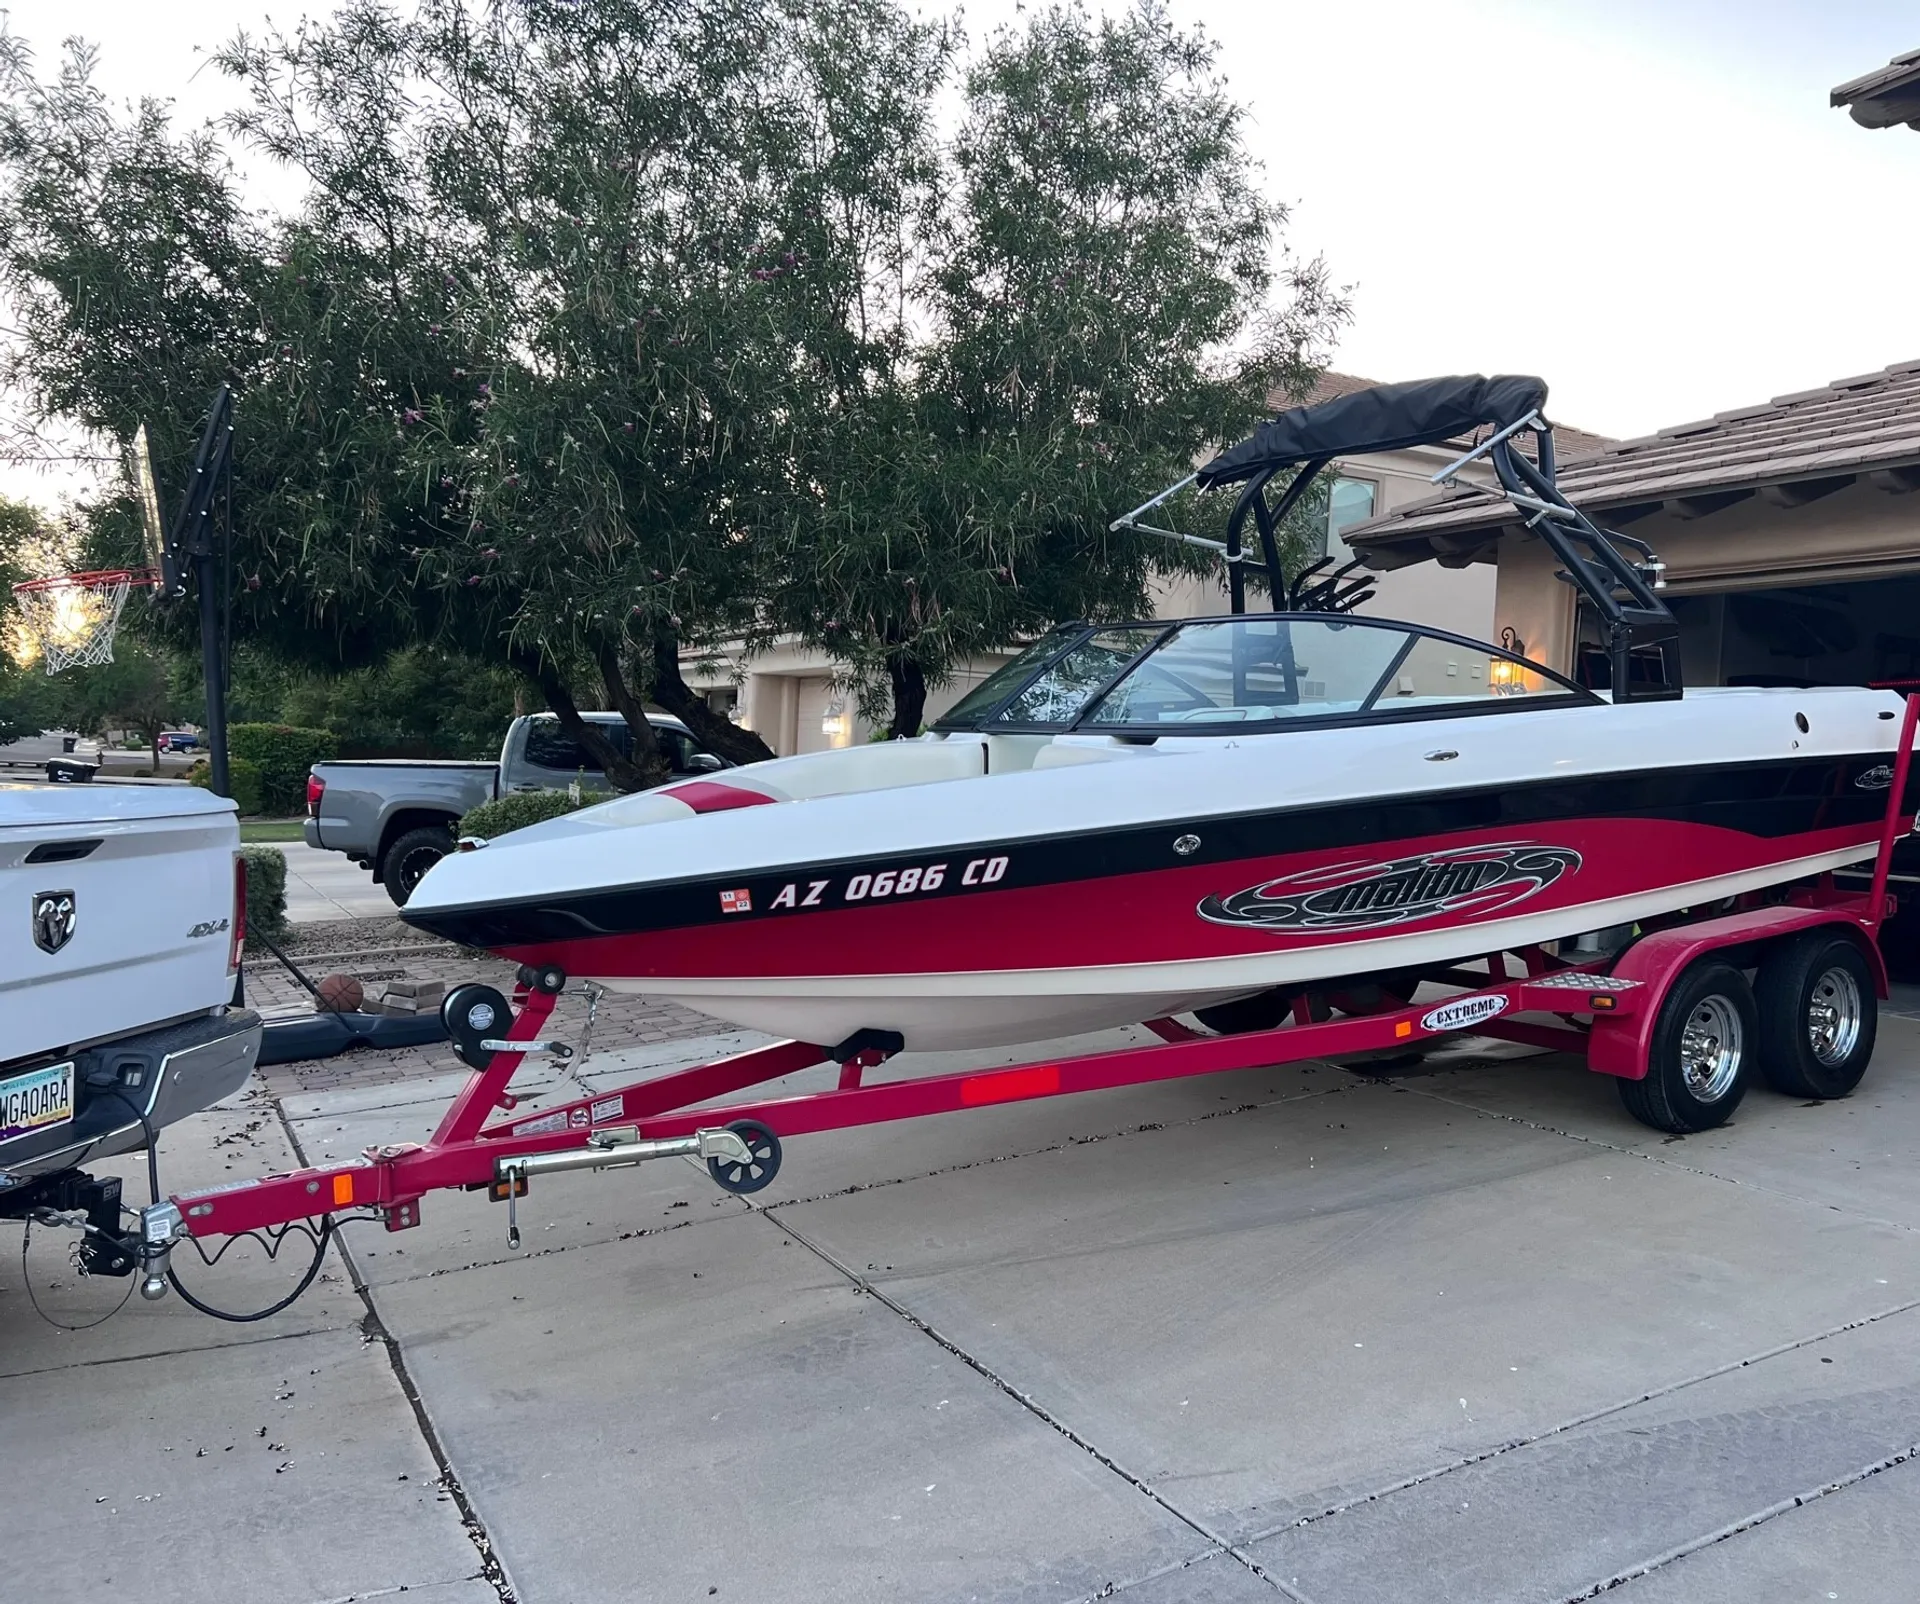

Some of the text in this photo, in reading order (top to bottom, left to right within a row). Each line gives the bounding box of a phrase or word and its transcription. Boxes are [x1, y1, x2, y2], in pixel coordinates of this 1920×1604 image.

[768, 856, 1009, 910] AZ 0686 CD
[1329, 862, 1487, 913] malibu
[1436, 998, 1496, 1024] EXTREME
